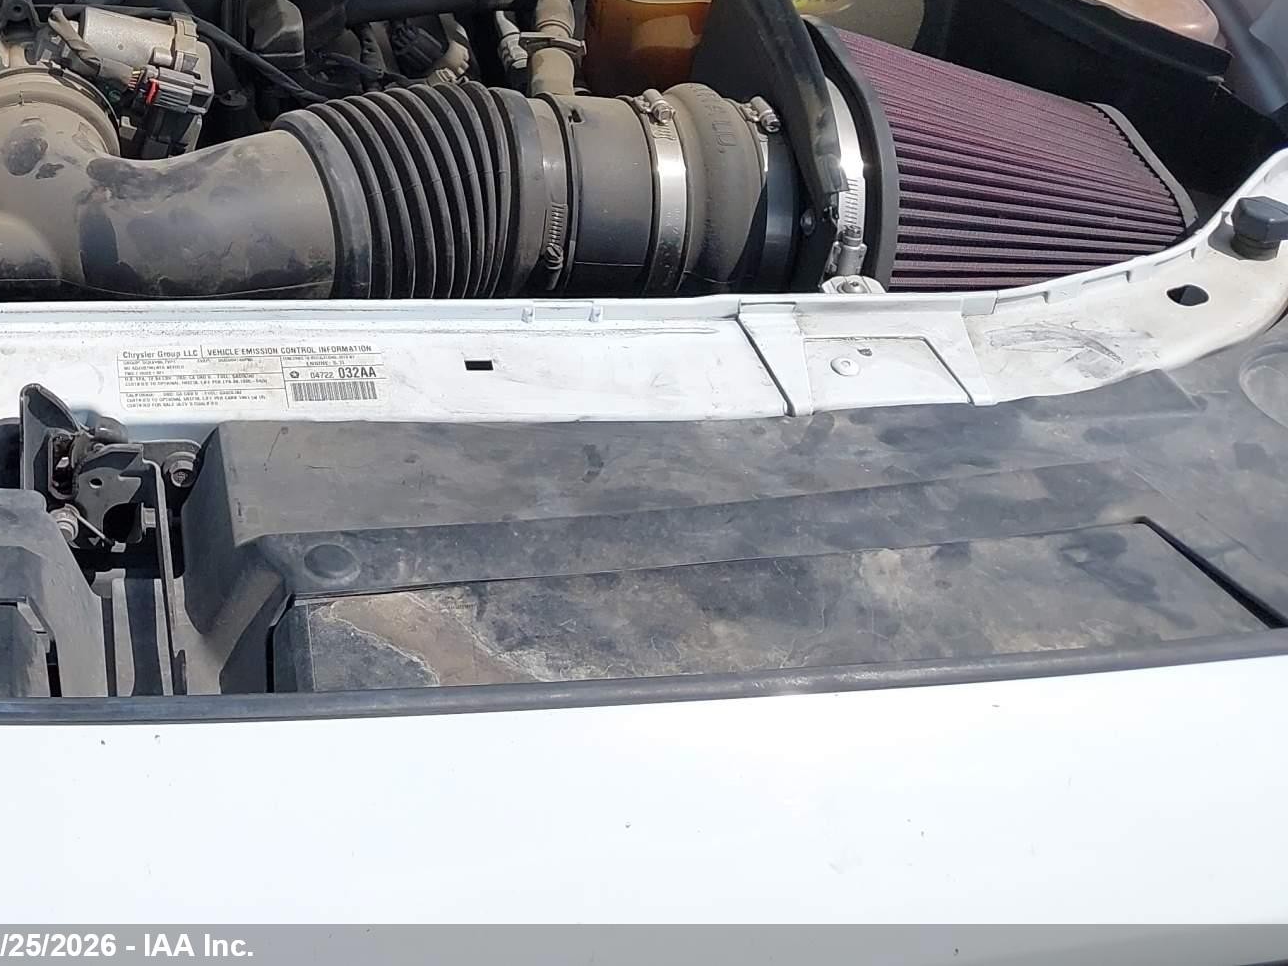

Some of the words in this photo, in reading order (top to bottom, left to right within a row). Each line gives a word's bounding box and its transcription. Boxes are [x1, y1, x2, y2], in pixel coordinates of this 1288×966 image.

[123, 349, 155, 360] Chrysler
[157, 349, 181, 359] Group
[183, 349, 198, 357] LLC
[207, 348, 239, 356] VEHICLE
[241, 347, 279, 355] EMISSION
[280, 346, 316, 354] CONTROL
[318, 345, 372, 353] INFORMATION
[310, 371, 334, 379] 04722
[338, 366, 377, 379] 032AA
